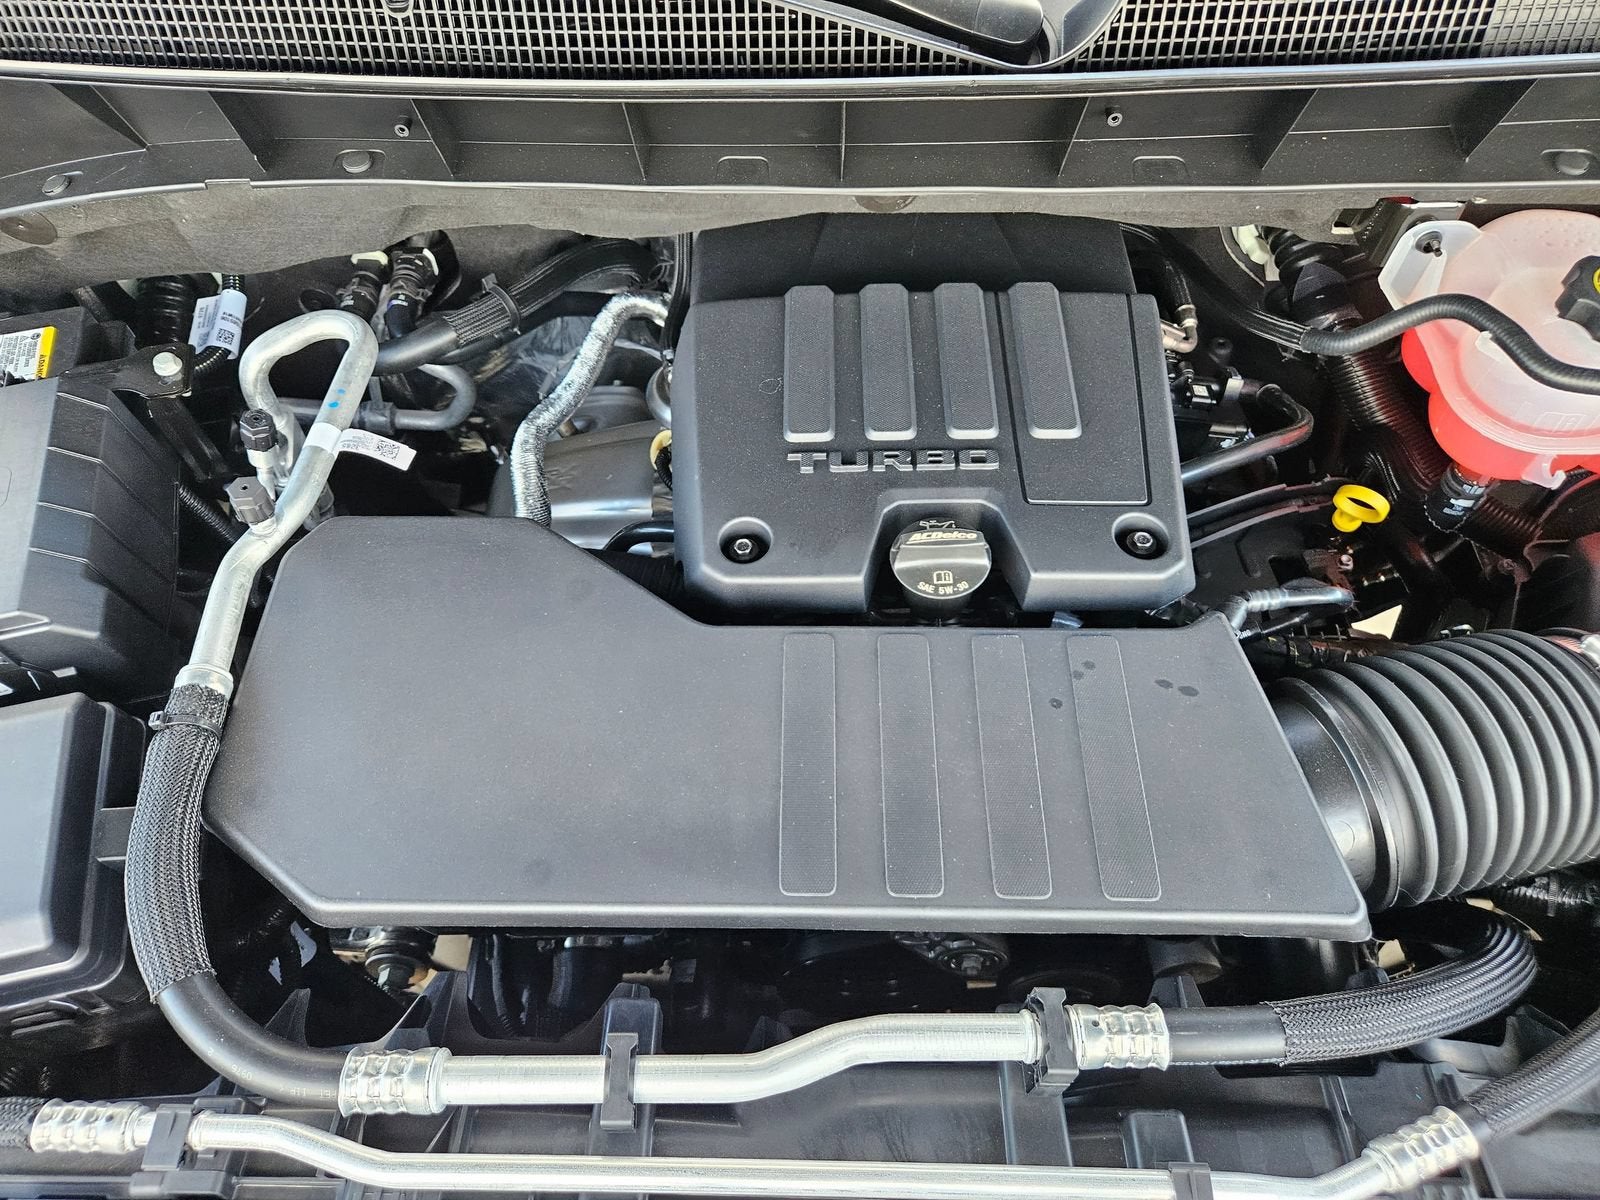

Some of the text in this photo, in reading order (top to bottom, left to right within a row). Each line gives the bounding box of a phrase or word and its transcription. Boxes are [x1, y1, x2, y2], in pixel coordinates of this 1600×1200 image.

[787, 450, 1000, 473] TURBO
[908, 531, 977, 541] ACDelco
[917, 581, 969, 594] SAE 5W-30
